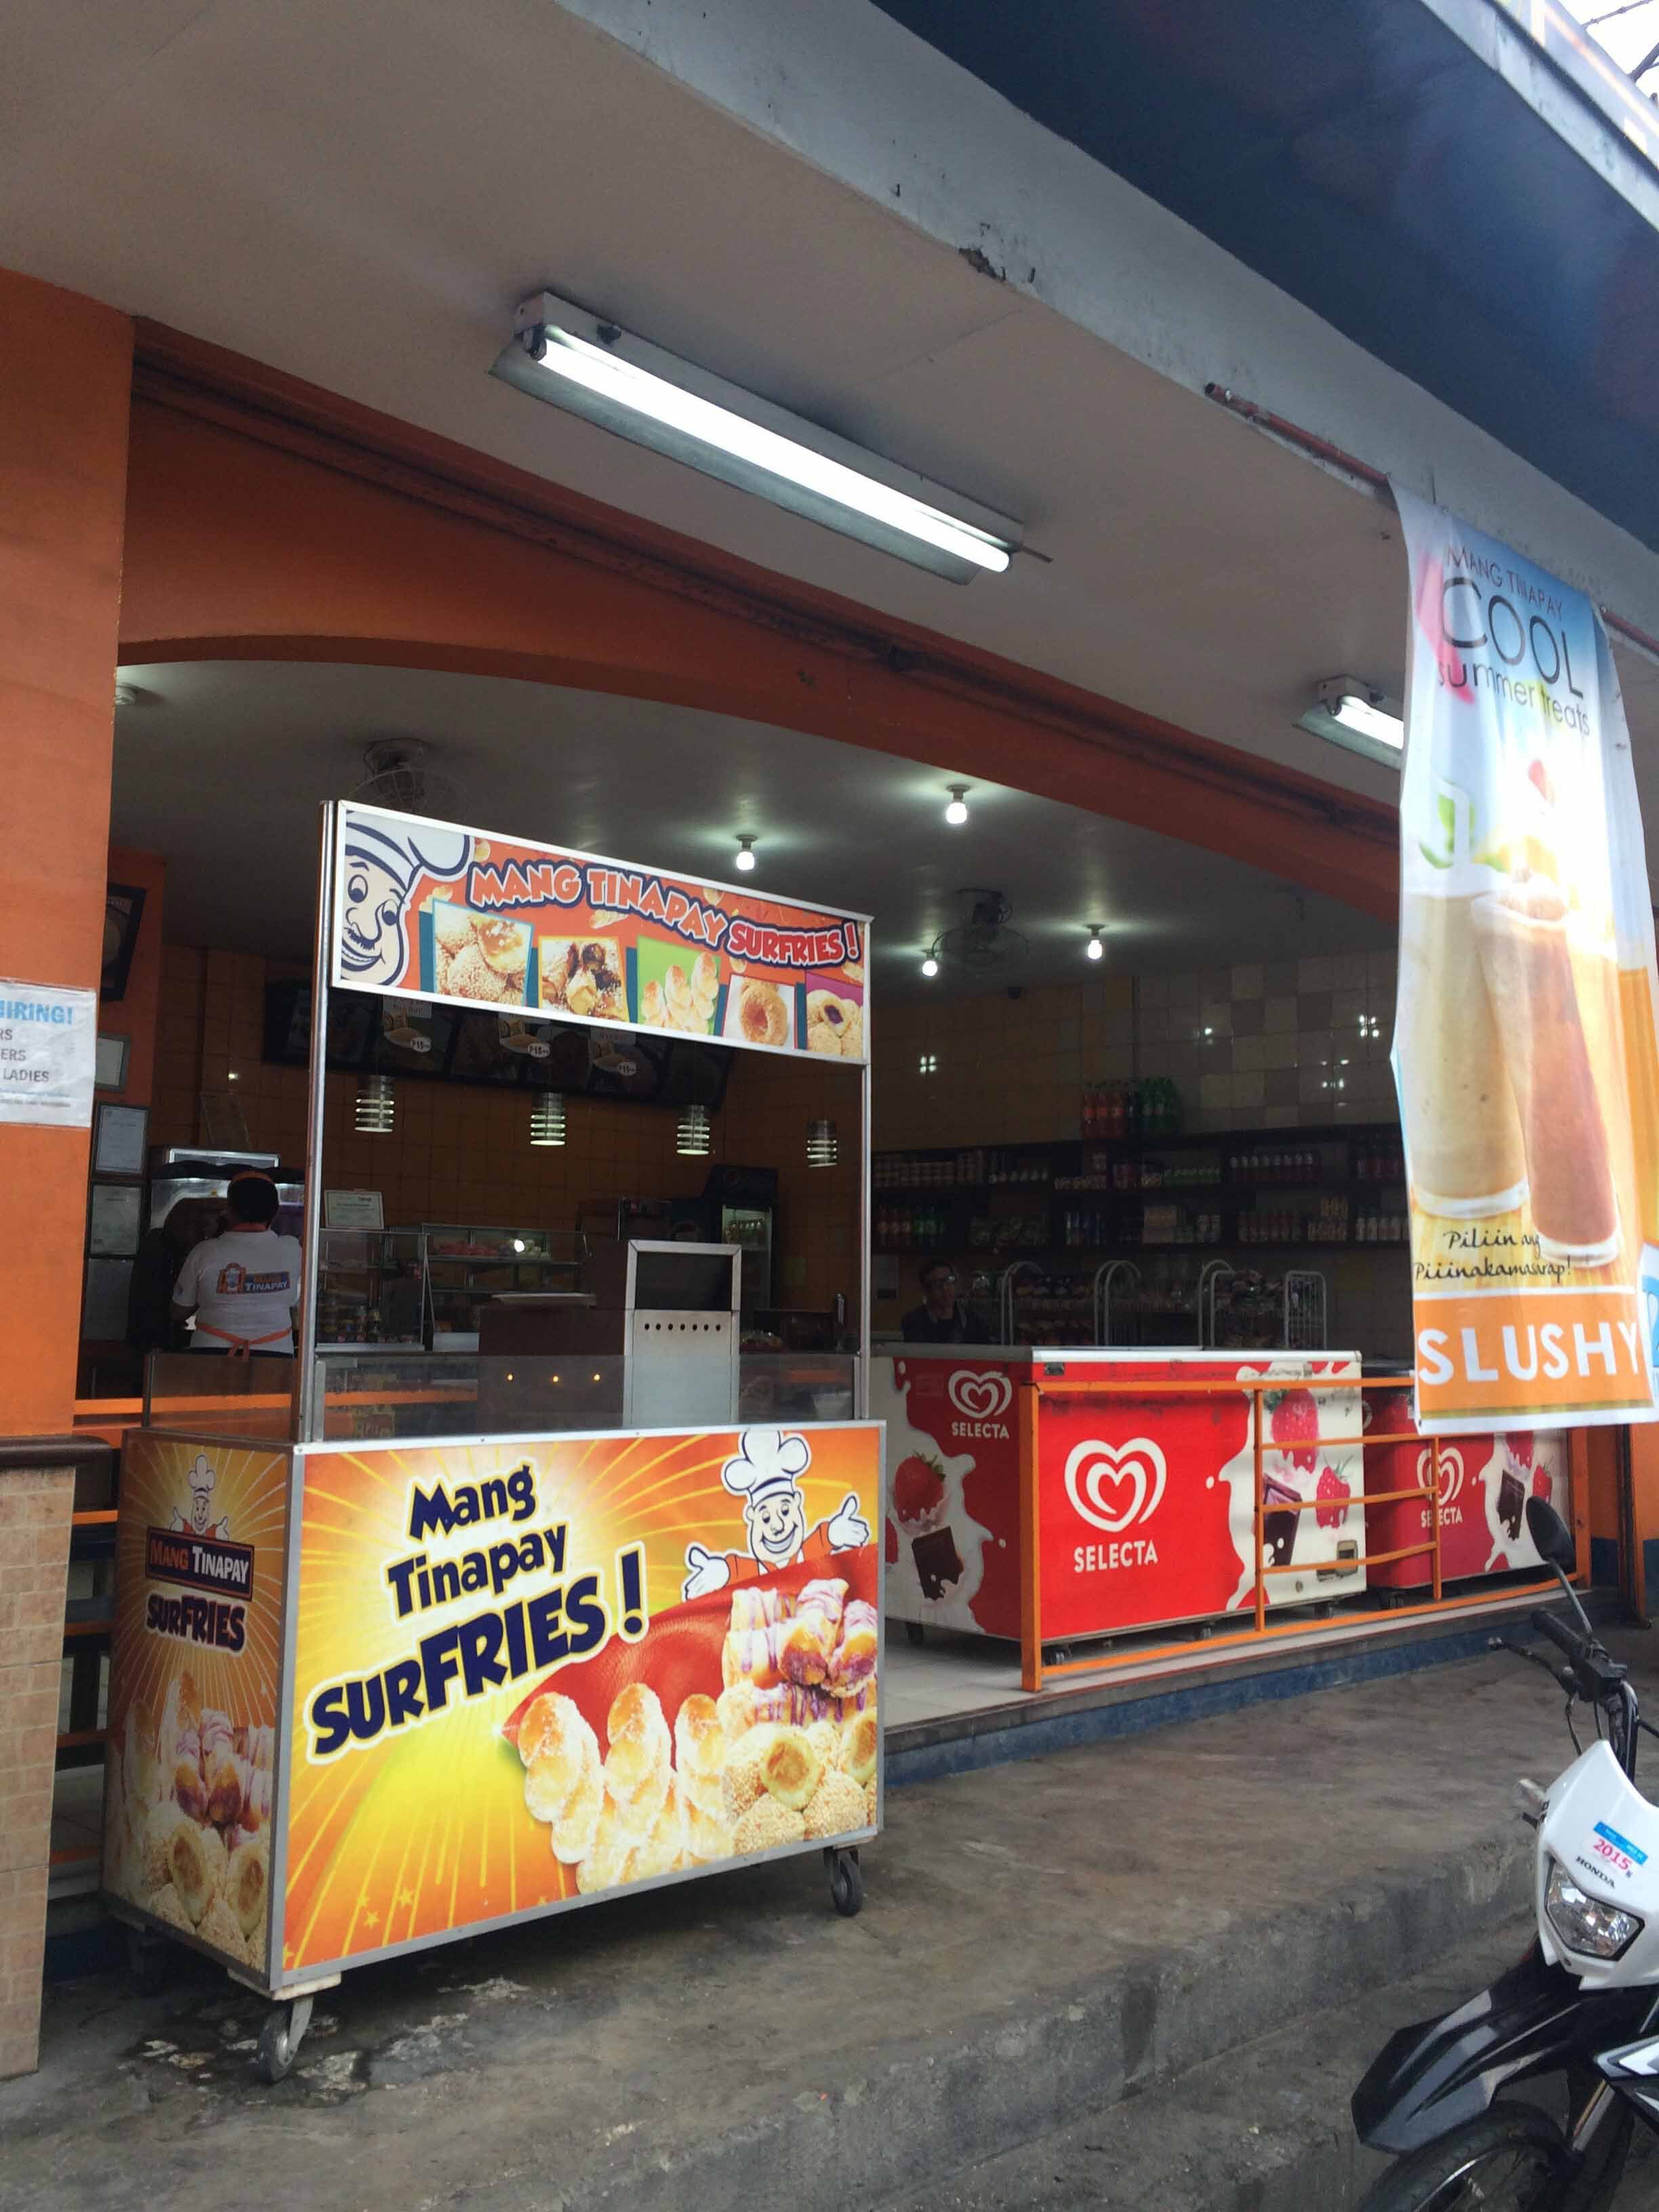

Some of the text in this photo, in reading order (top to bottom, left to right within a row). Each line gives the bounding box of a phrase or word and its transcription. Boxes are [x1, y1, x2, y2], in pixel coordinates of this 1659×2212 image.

[1448, 547, 1503, 588] MANG
[1440, 577, 1583, 699] COOL
[1438, 661, 1591, 736] summer treats
[470, 865, 581, 908] MANG
[587, 870, 728, 947] TINAPAY
[3, 1069, 49, 1083] LADIES
[1443, 1227, 1517, 1250] Piliin
[244, 1281, 287, 1291] TINAPAY
[1418, 1322, 1640, 1385] SLUSHY
[951, 1421, 1010, 1439] SELECTA
[408, 1465, 537, 1541] Mang
[150, 1540, 250, 1584] MANG TINAPAY
[387, 1524, 567, 1619] Tinapay
[1073, 1540, 1159, 1573] SELECTA
[146, 1593, 246, 1654] SURFRIES
[1576, 1856, 1615, 1889] HONDA
[1594, 1838, 1633, 1870] 2015
